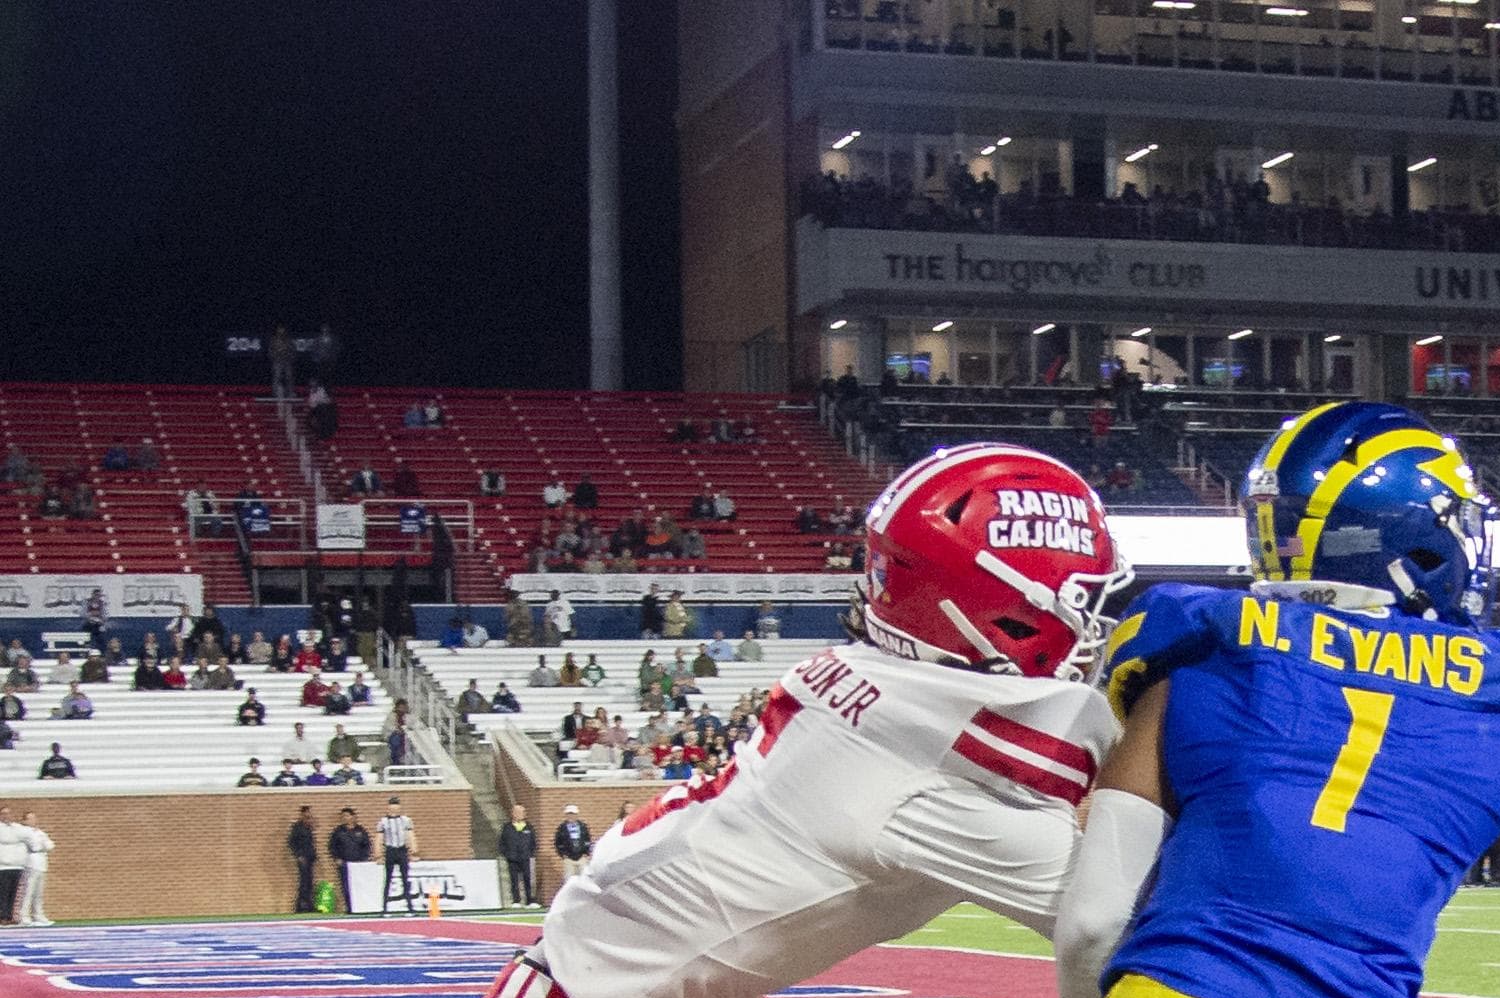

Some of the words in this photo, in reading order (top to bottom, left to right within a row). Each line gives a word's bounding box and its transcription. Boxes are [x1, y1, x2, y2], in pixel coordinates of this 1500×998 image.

[885, 253, 945, 281] THE
[955, 243, 1101, 292] hargrove
[1127, 261, 1205, 288] CLUB
[996, 489, 1089, 524] RAGIN
[987, 518, 1096, 558] CAJUNS
[1239, 597, 1290, 652] N.
[1310, 613, 1485, 696] EVANS
[829, 679, 880, 727] JR
[1310, 687, 1395, 833] 1
